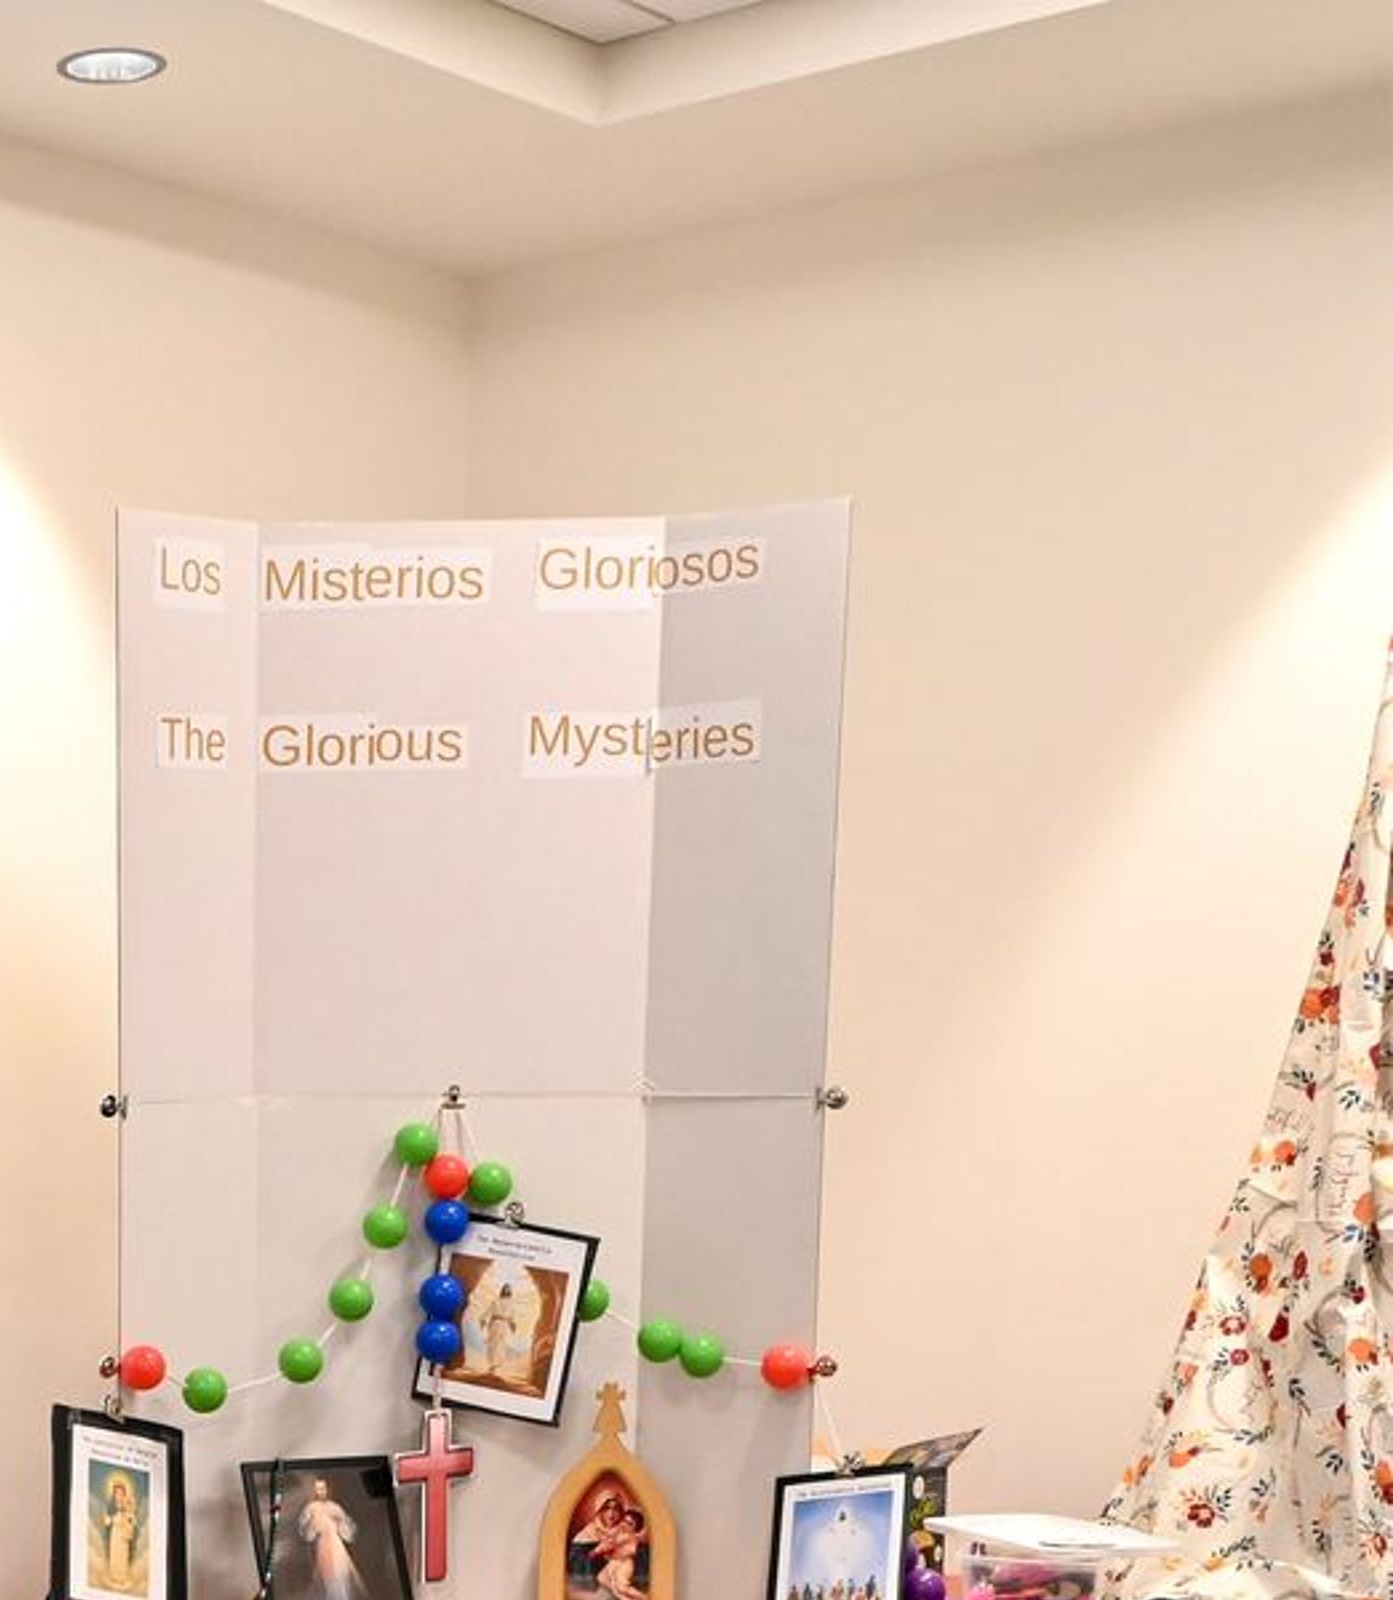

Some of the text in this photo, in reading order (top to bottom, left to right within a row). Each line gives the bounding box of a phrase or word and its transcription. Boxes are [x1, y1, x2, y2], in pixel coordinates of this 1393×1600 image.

[159, 544, 760, 601] Los Misterios Gloriosos
[160, 714, 755, 768] The Glorious Mysteries
